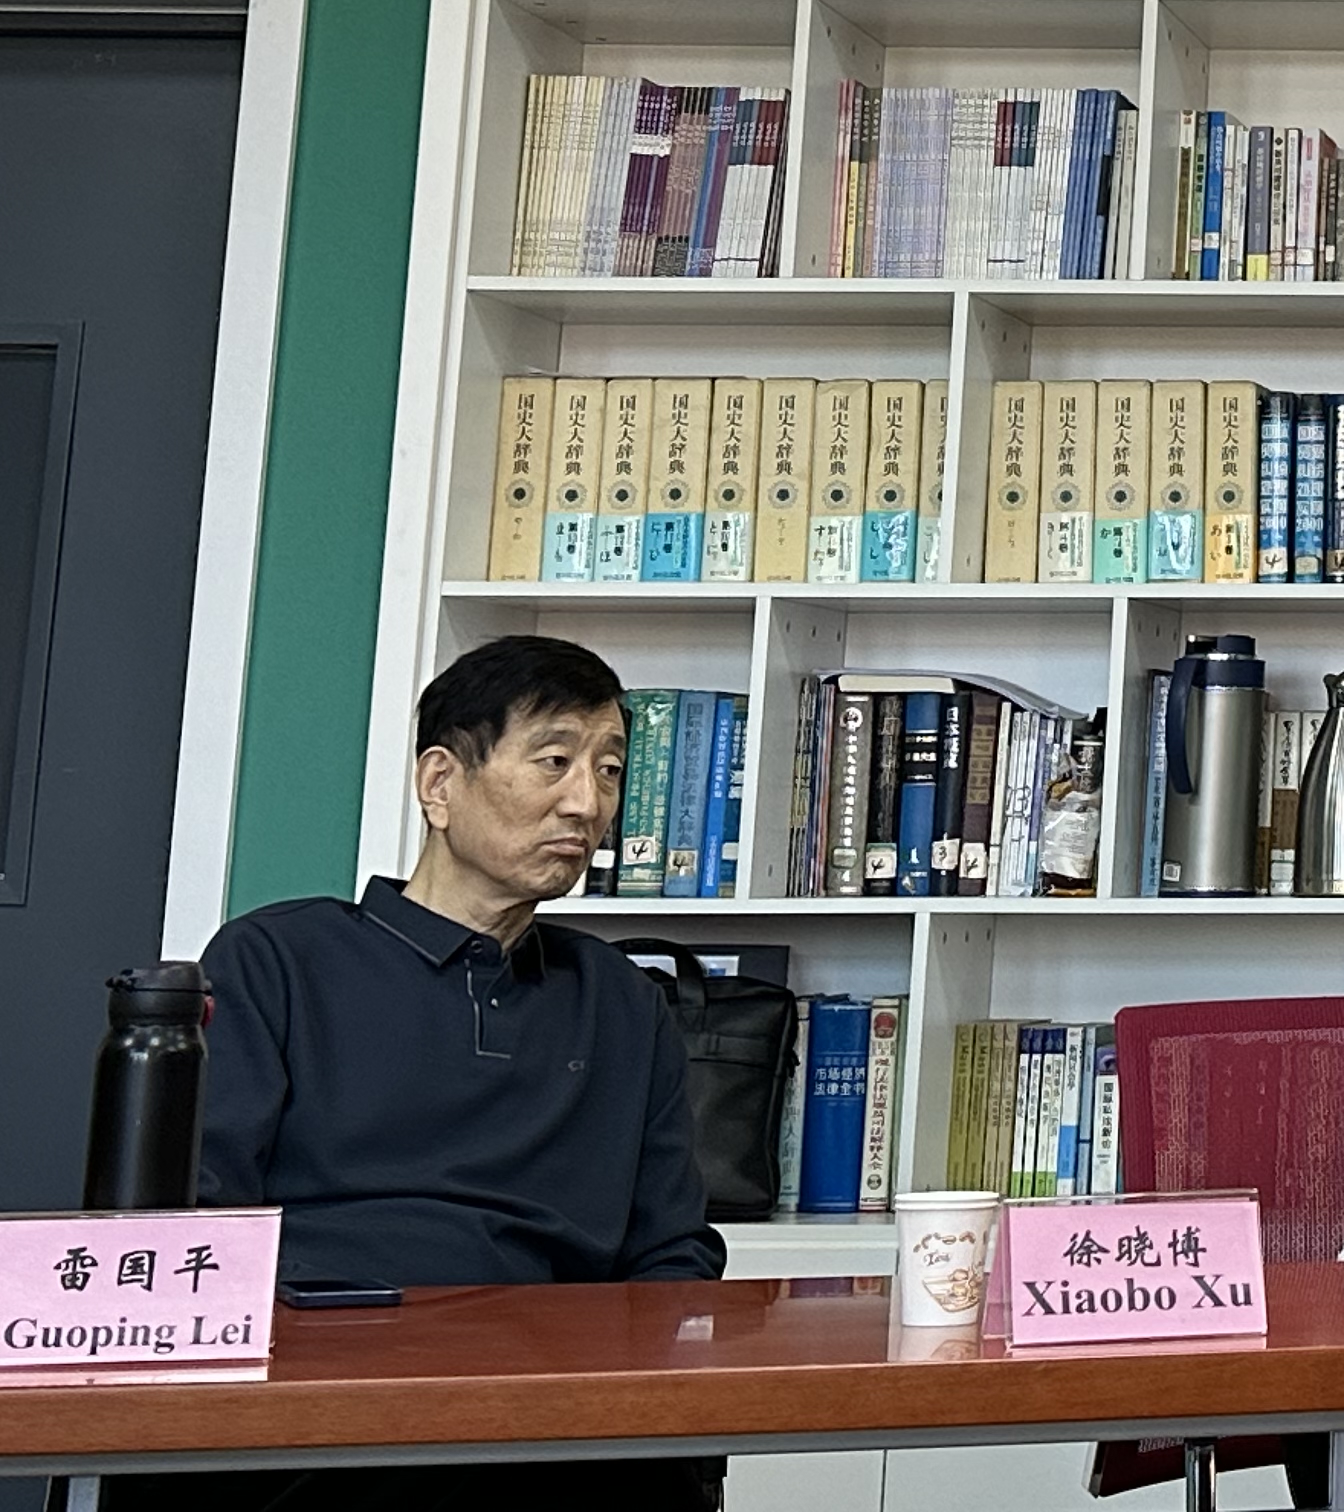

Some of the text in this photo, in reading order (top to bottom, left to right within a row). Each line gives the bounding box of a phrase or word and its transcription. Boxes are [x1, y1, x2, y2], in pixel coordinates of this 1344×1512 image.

[512, 393, 535, 475] 国史大辞典
[564, 395, 587, 476] 国史大辞典
[615, 395, 637, 476] 国史大辞典
[668, 393, 689, 475] 国史大辞典
[722, 394, 744, 476] 国史大辞典
[775, 394, 796, 476] 国史大辞典
[829, 395, 849, 476] 国史大辞典
[883, 396, 903, 477] 国史大辞典
[1005, 396, 1025, 478] 国史大辞典
[1057, 396, 1077, 478] 国史大辞典
[1112, 396, 1132, 478] 国史大辞典
[1167, 397, 1185, 478] 国史大辞典
[1222, 396, 1239, 478] 国史大辞典
[53, 1245, 220, 1294] 雷国平
[1062, 1225, 1208, 1269] 徐晓博
[4, 1314, 253, 1357] Guoping Lei
[1021, 1273, 1254, 1318] Xiaobo Xu
